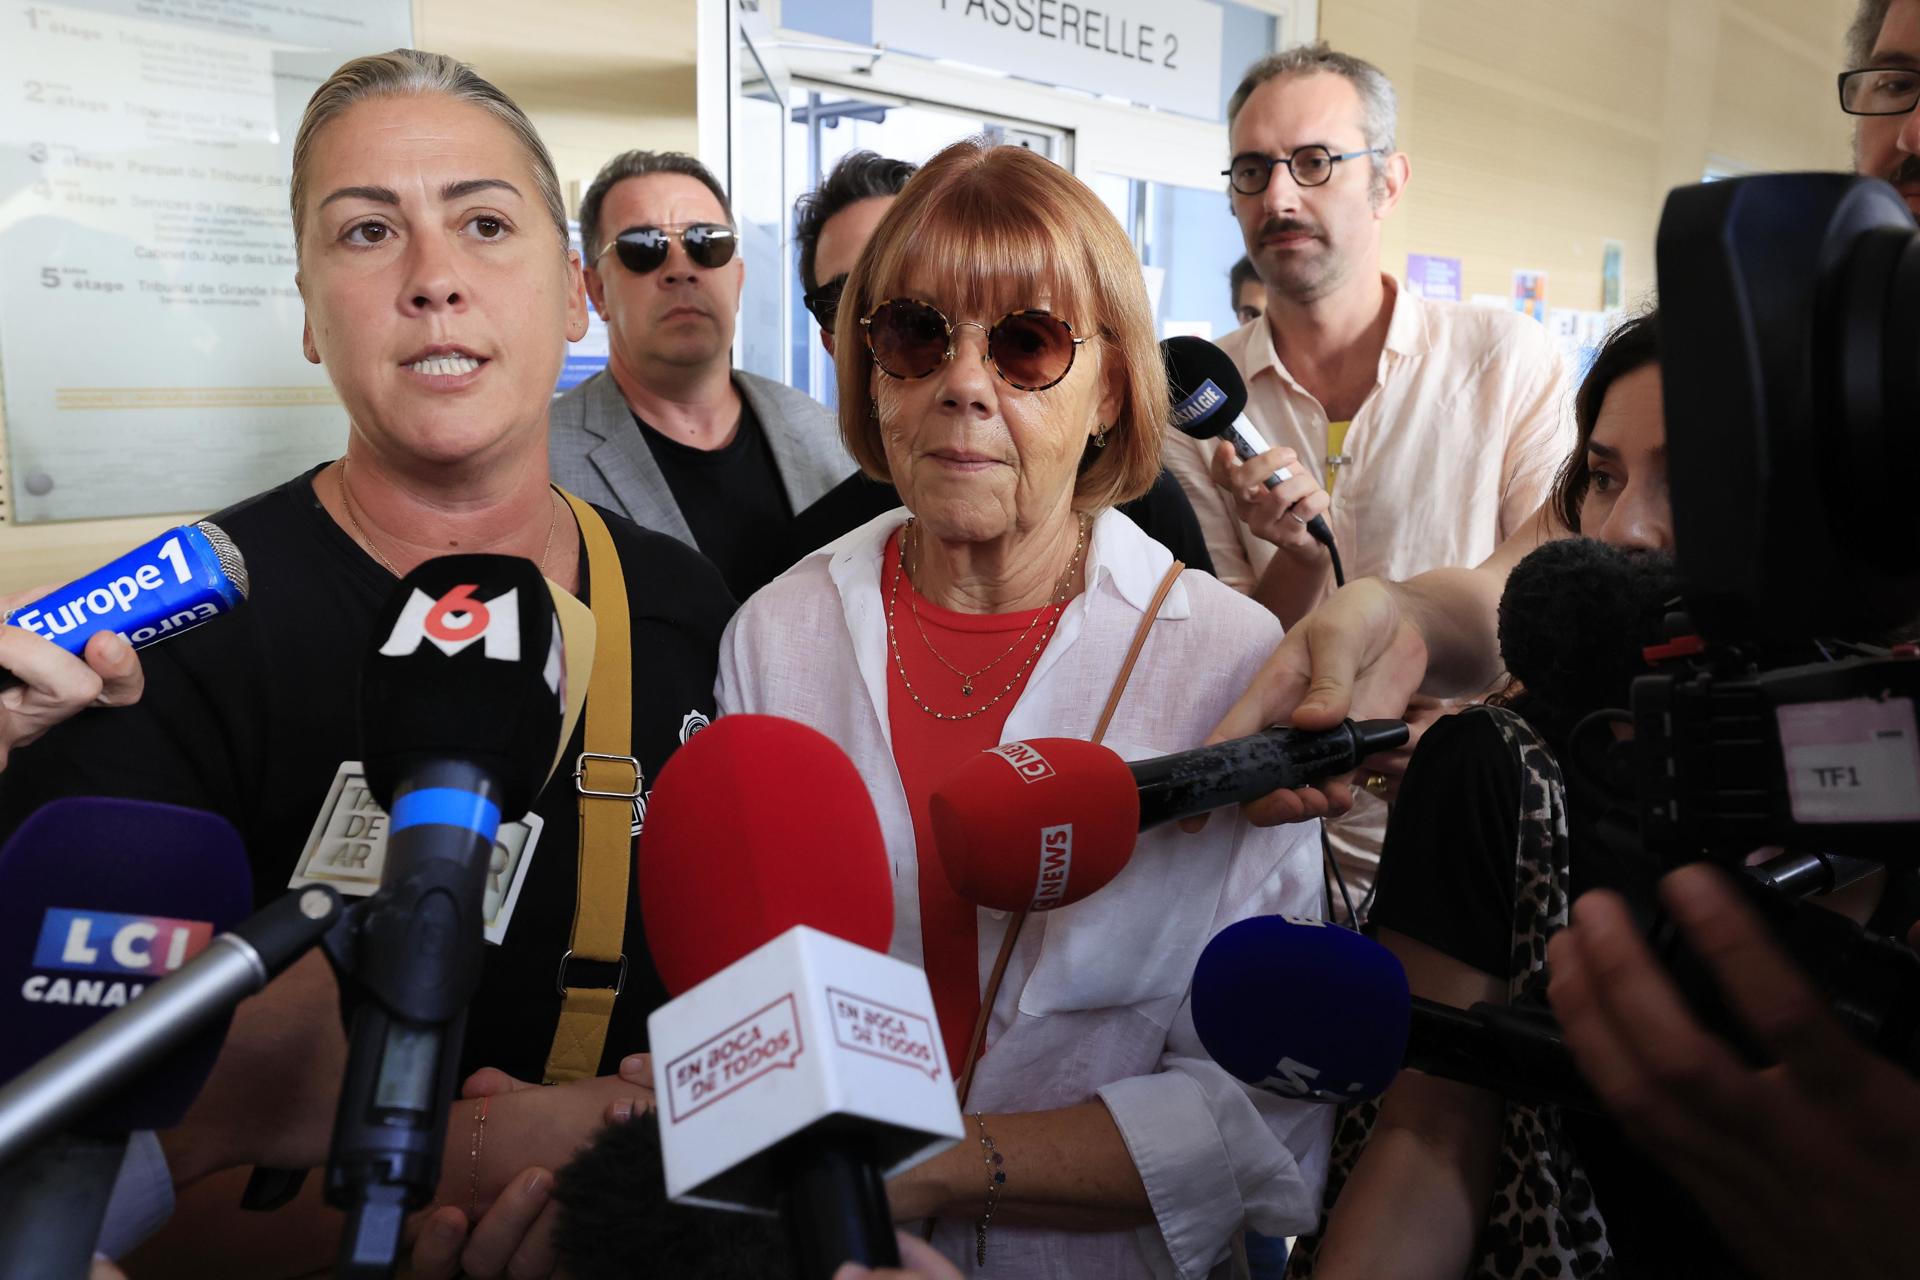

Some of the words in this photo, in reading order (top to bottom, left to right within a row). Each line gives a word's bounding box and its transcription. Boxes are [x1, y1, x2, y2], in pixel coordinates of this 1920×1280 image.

[940, 0, 1155, 64] ASSERELLE
[1163, 33, 1179, 70] 2
[1175, 386, 1220, 421] TALGIE
[17, 564, 165, 642] Europe
[157, 537, 193, 584] 1
[117, 602, 220, 647] Euro
[1812, 766, 1862, 788] TF1
[61, 917, 190, 969] LCI
[836, 1000, 859, 1021] EN
[863, 1007, 908, 1035] BOCA
[677, 1057, 702, 1089] EN
[708, 1026, 763, 1069] BOCA
[691, 1072, 716, 1102] DE
[722, 1029, 790, 1083] TODOS
[851, 1024, 873, 1046] DE
[878, 1031, 931, 1061] TODOS
